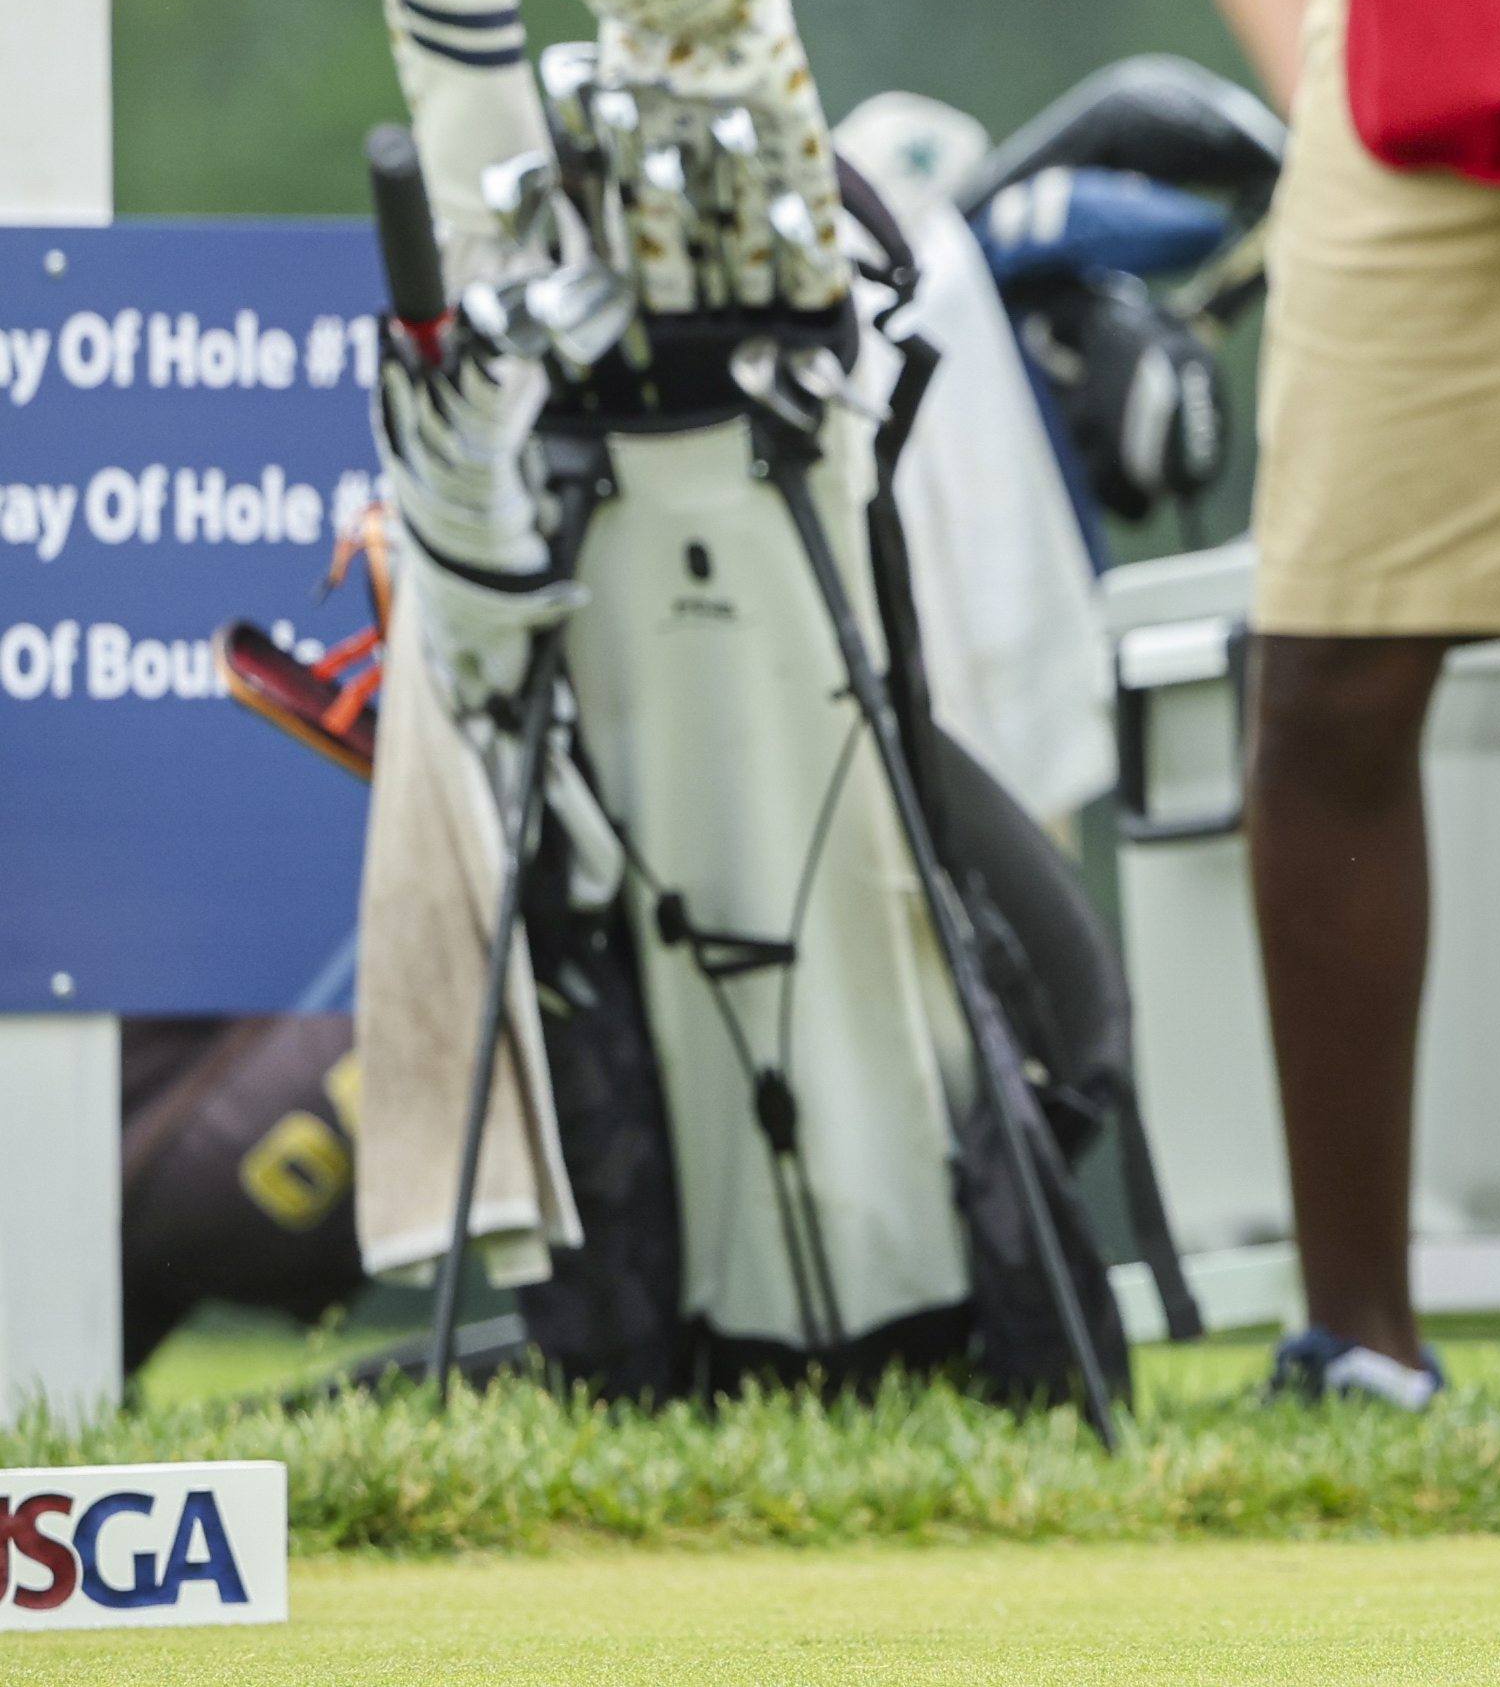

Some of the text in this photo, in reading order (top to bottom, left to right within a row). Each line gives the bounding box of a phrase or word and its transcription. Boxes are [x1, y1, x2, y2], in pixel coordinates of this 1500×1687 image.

[58, 308, 142, 389] Of
[148, 308, 297, 389] Hole
[84, 463, 169, 545] Of
[174, 463, 323, 545] Hole
[0, 618, 80, 700] Of
[0, 1491, 249, 1610] SGA
